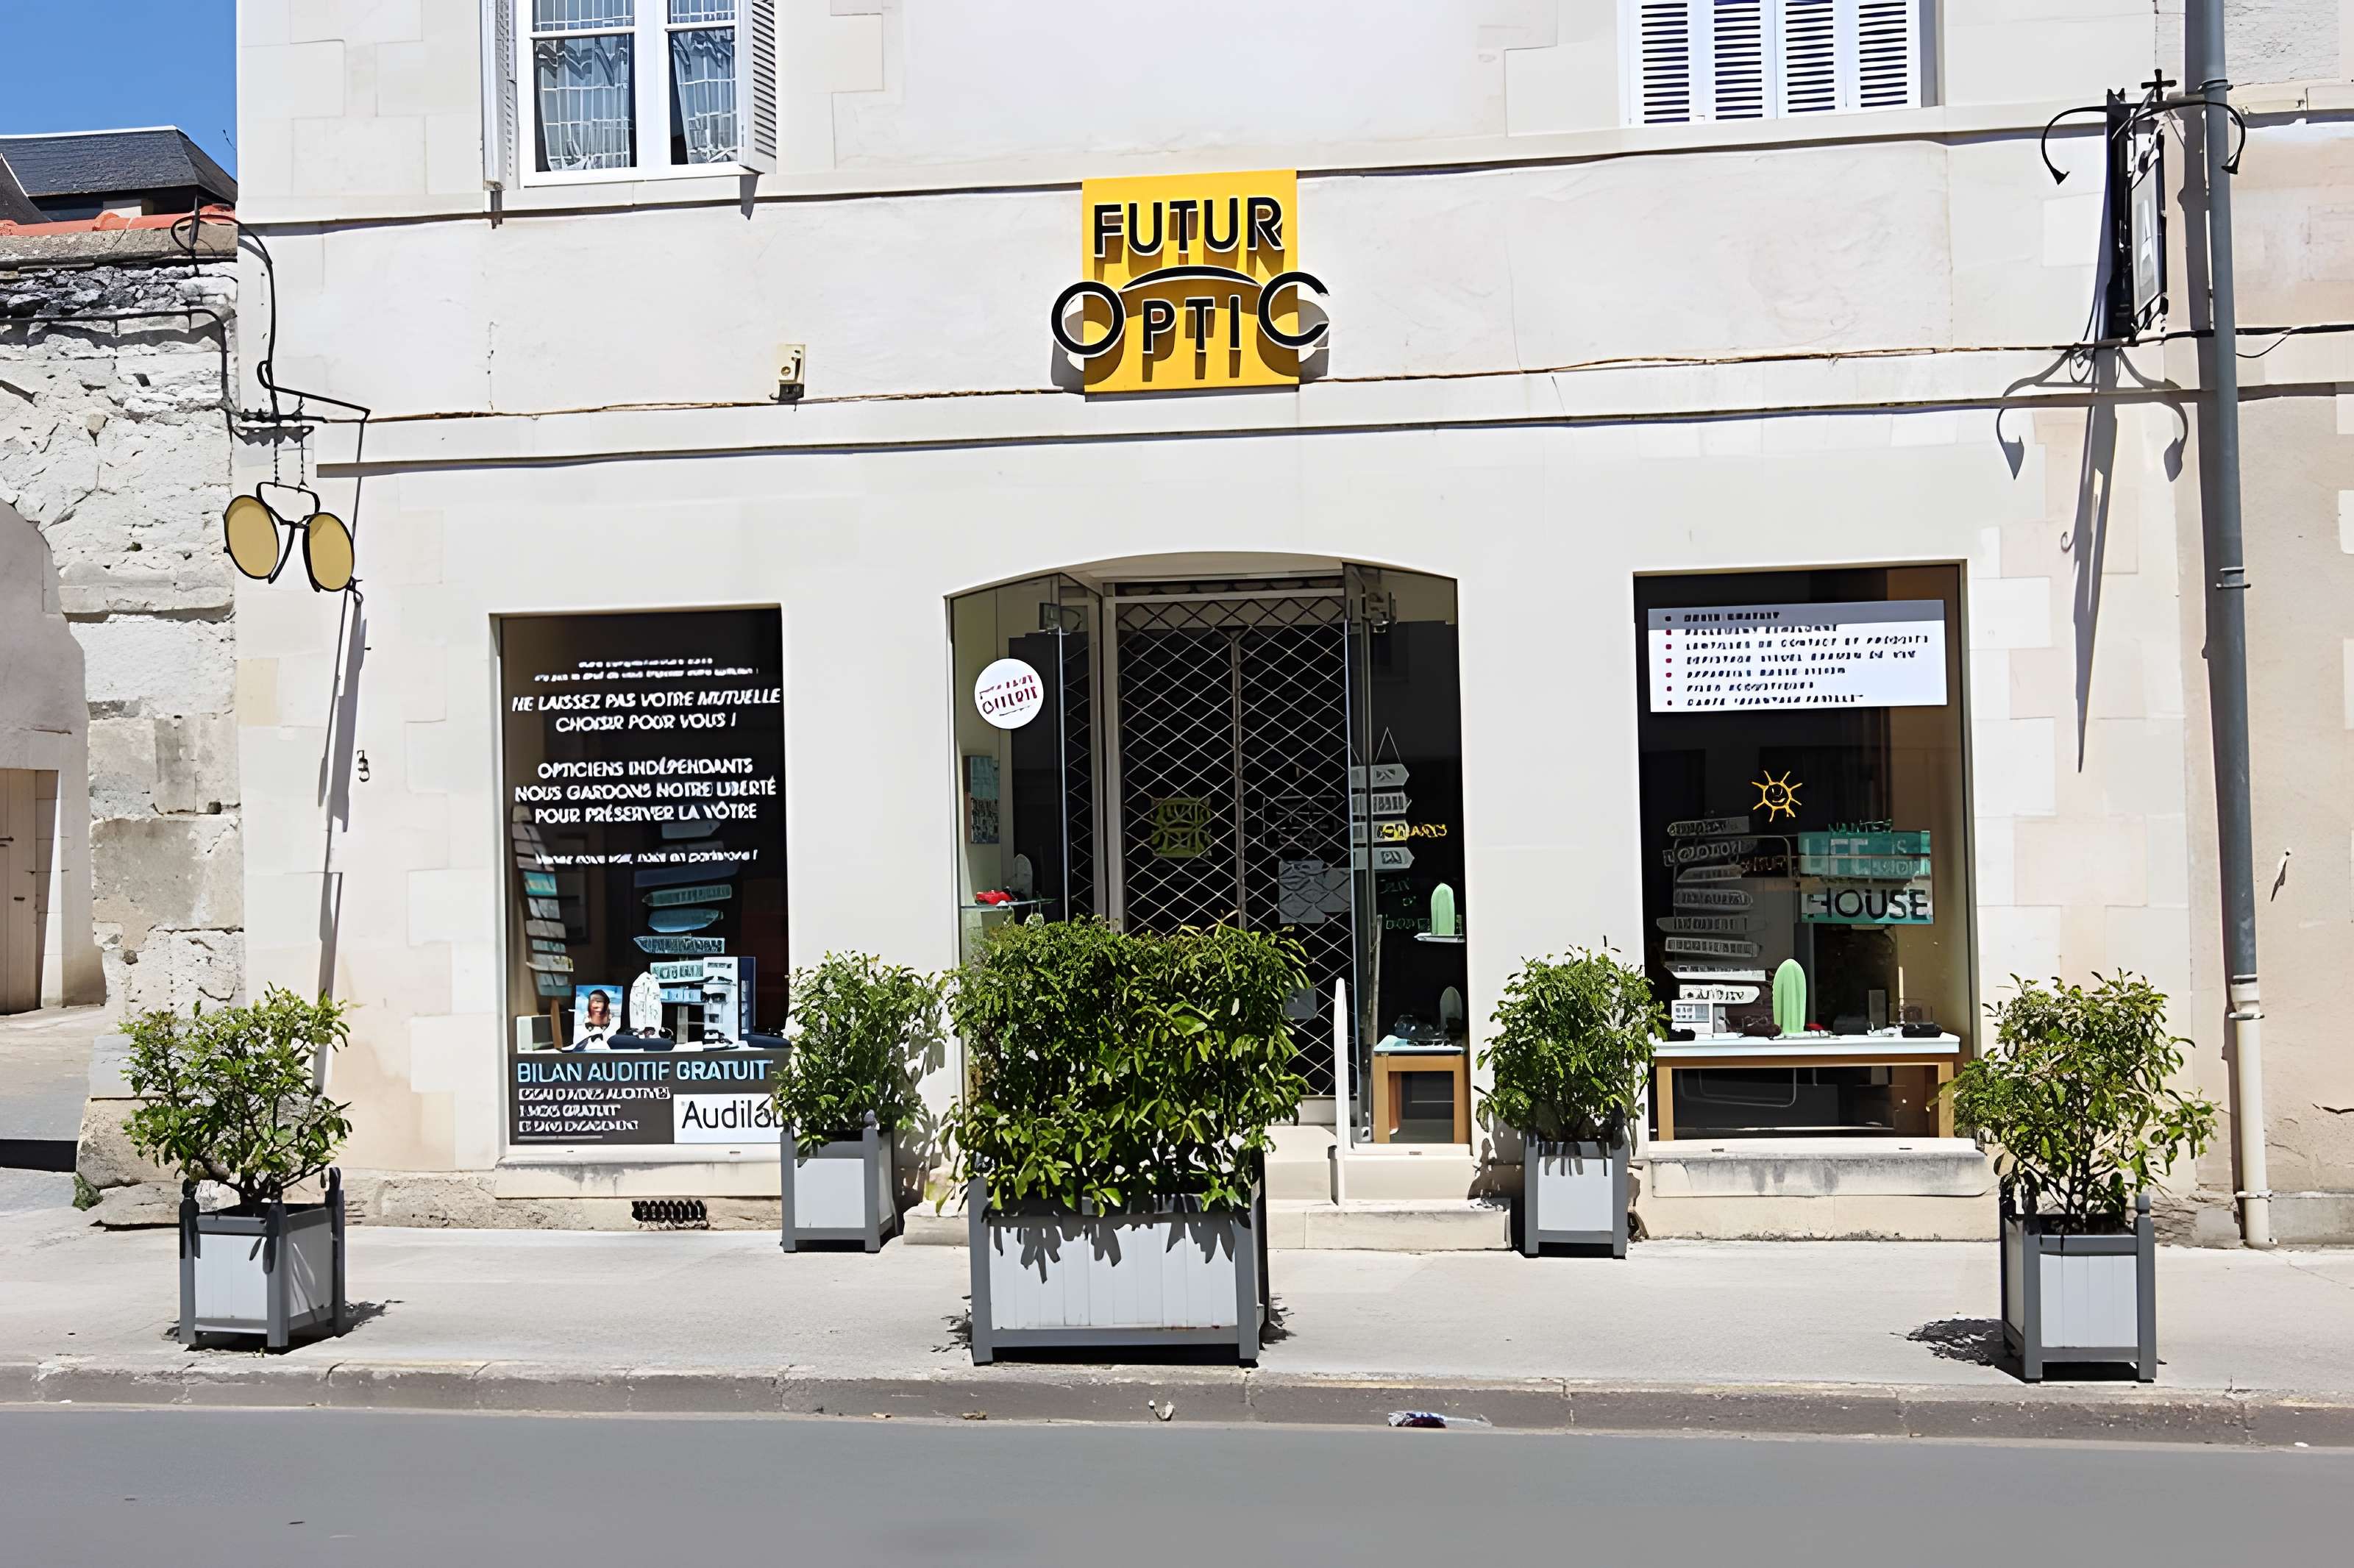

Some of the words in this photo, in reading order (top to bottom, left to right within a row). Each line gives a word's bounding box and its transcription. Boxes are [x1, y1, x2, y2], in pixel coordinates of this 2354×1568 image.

[1094, 196, 1284, 257] FUTUR
[1050, 271, 1330, 357] OPTIC
[538, 694, 601, 710] LAISSEZ
[605, 693, 636, 708] PAS
[641, 691, 694, 707] VOTRE
[697, 688, 780, 706] MUTUELLE
[628, 713, 675, 730] POUR
[680, 713, 725, 729] VOUS
[538, 761, 624, 779] OPTICIENS
[515, 785, 562, 802] NOUS
[656, 781, 713, 797] NOTRE
[536, 808, 580, 824] POUR
[678, 804, 700, 820] LA
[517, 1061, 582, 1083] BILAN
[676, 1060, 773, 1080] GRATUIT
